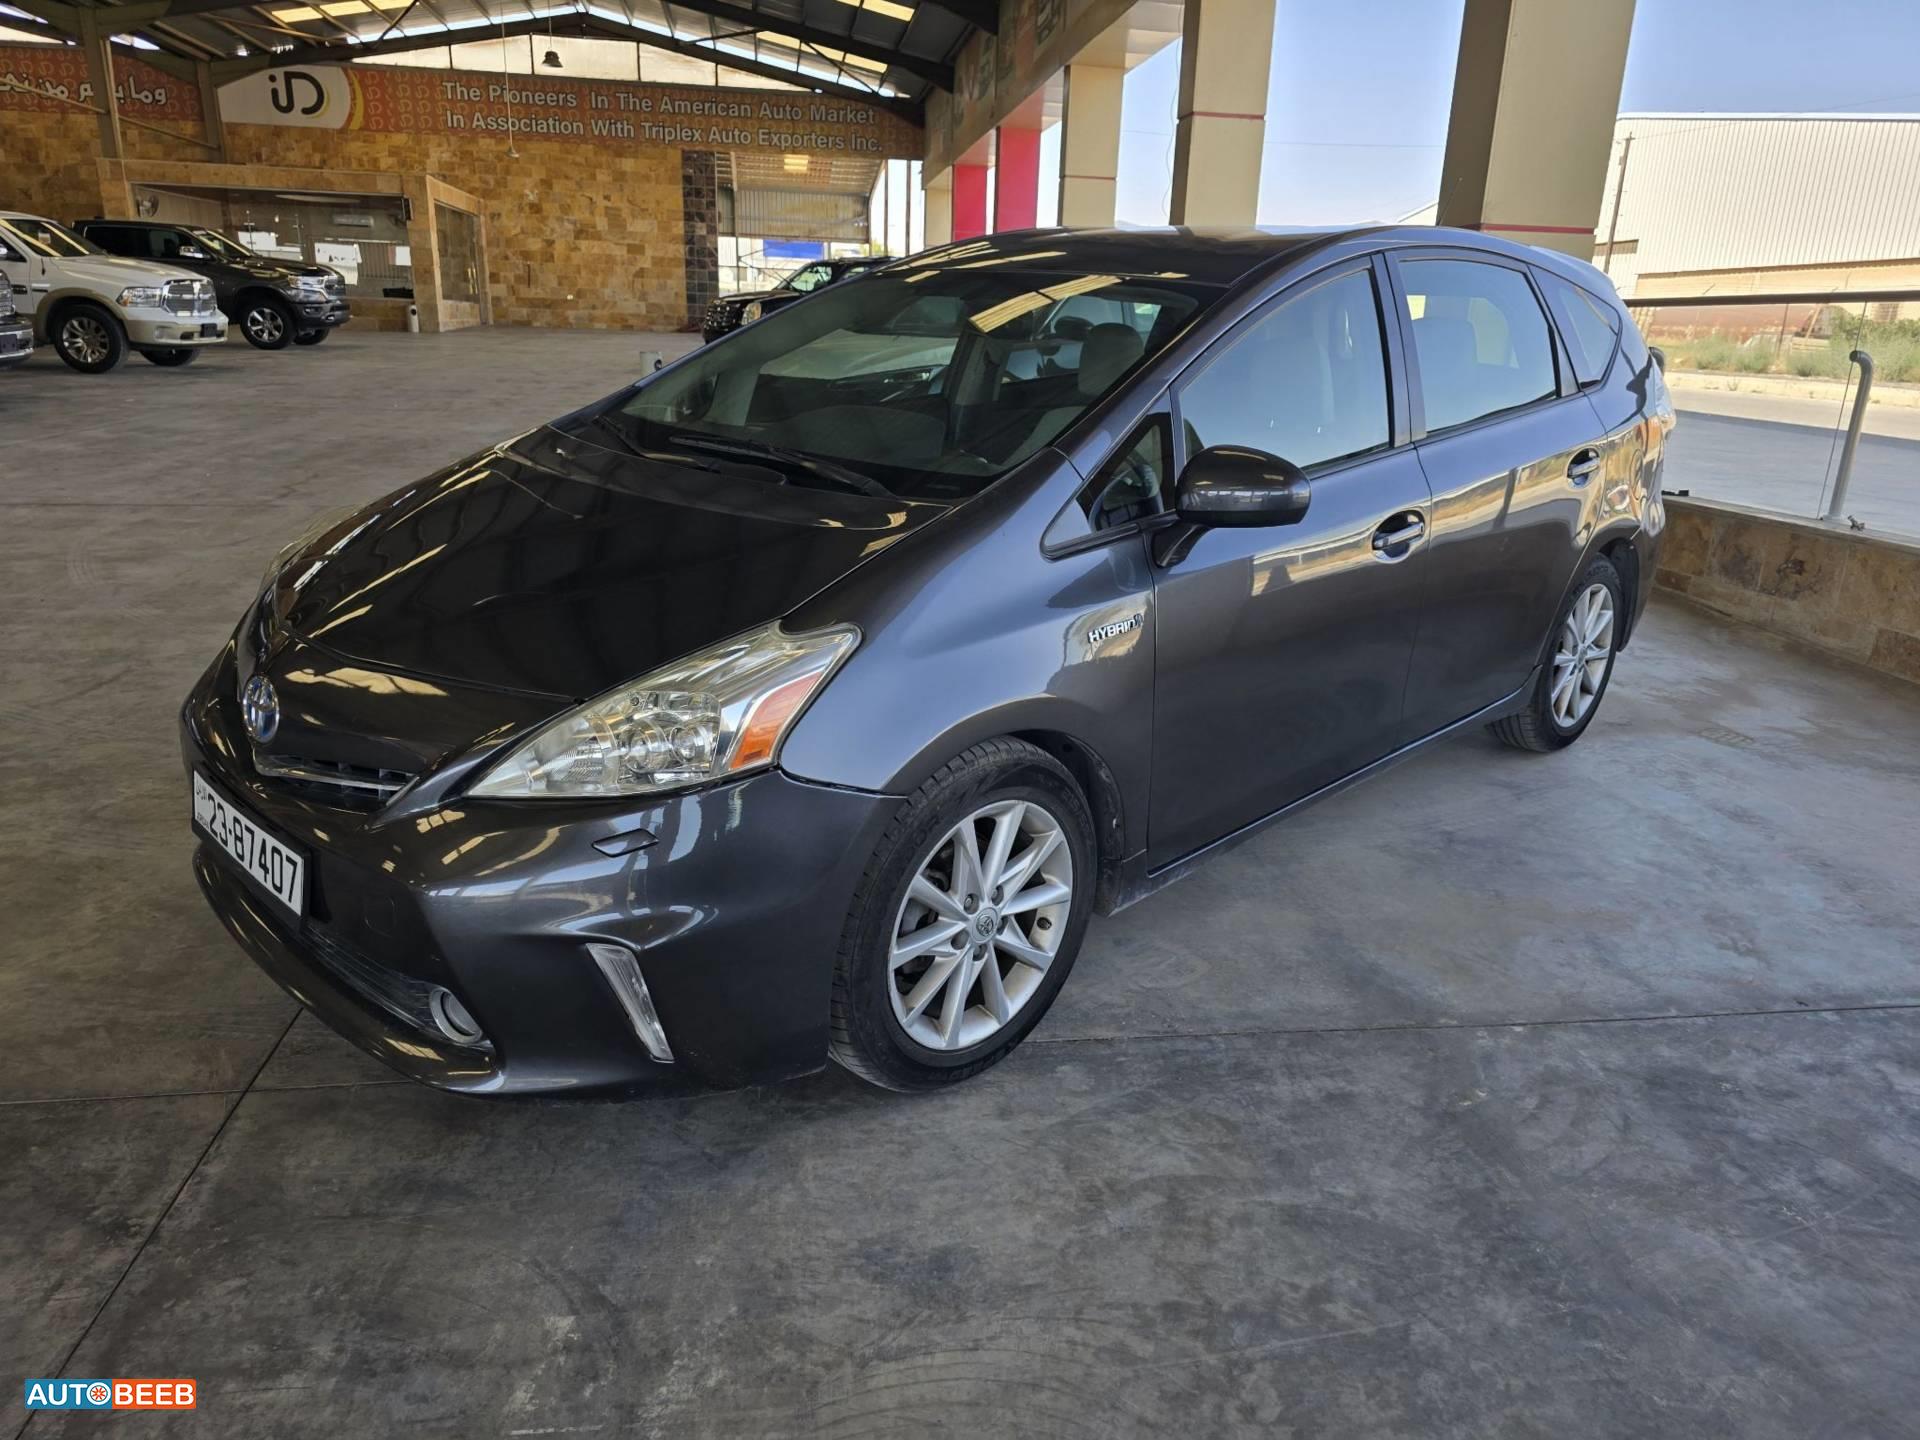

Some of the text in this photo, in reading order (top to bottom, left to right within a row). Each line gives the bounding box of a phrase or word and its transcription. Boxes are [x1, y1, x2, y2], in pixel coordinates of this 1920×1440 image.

[79, 81, 125, 104] بم
[128, 76, 167, 105] وما
[443, 81, 874, 125] The Pioneers In The American Auto Market
[446, 110, 882, 151] In Association With Triplex Auto Exporters Inc.
